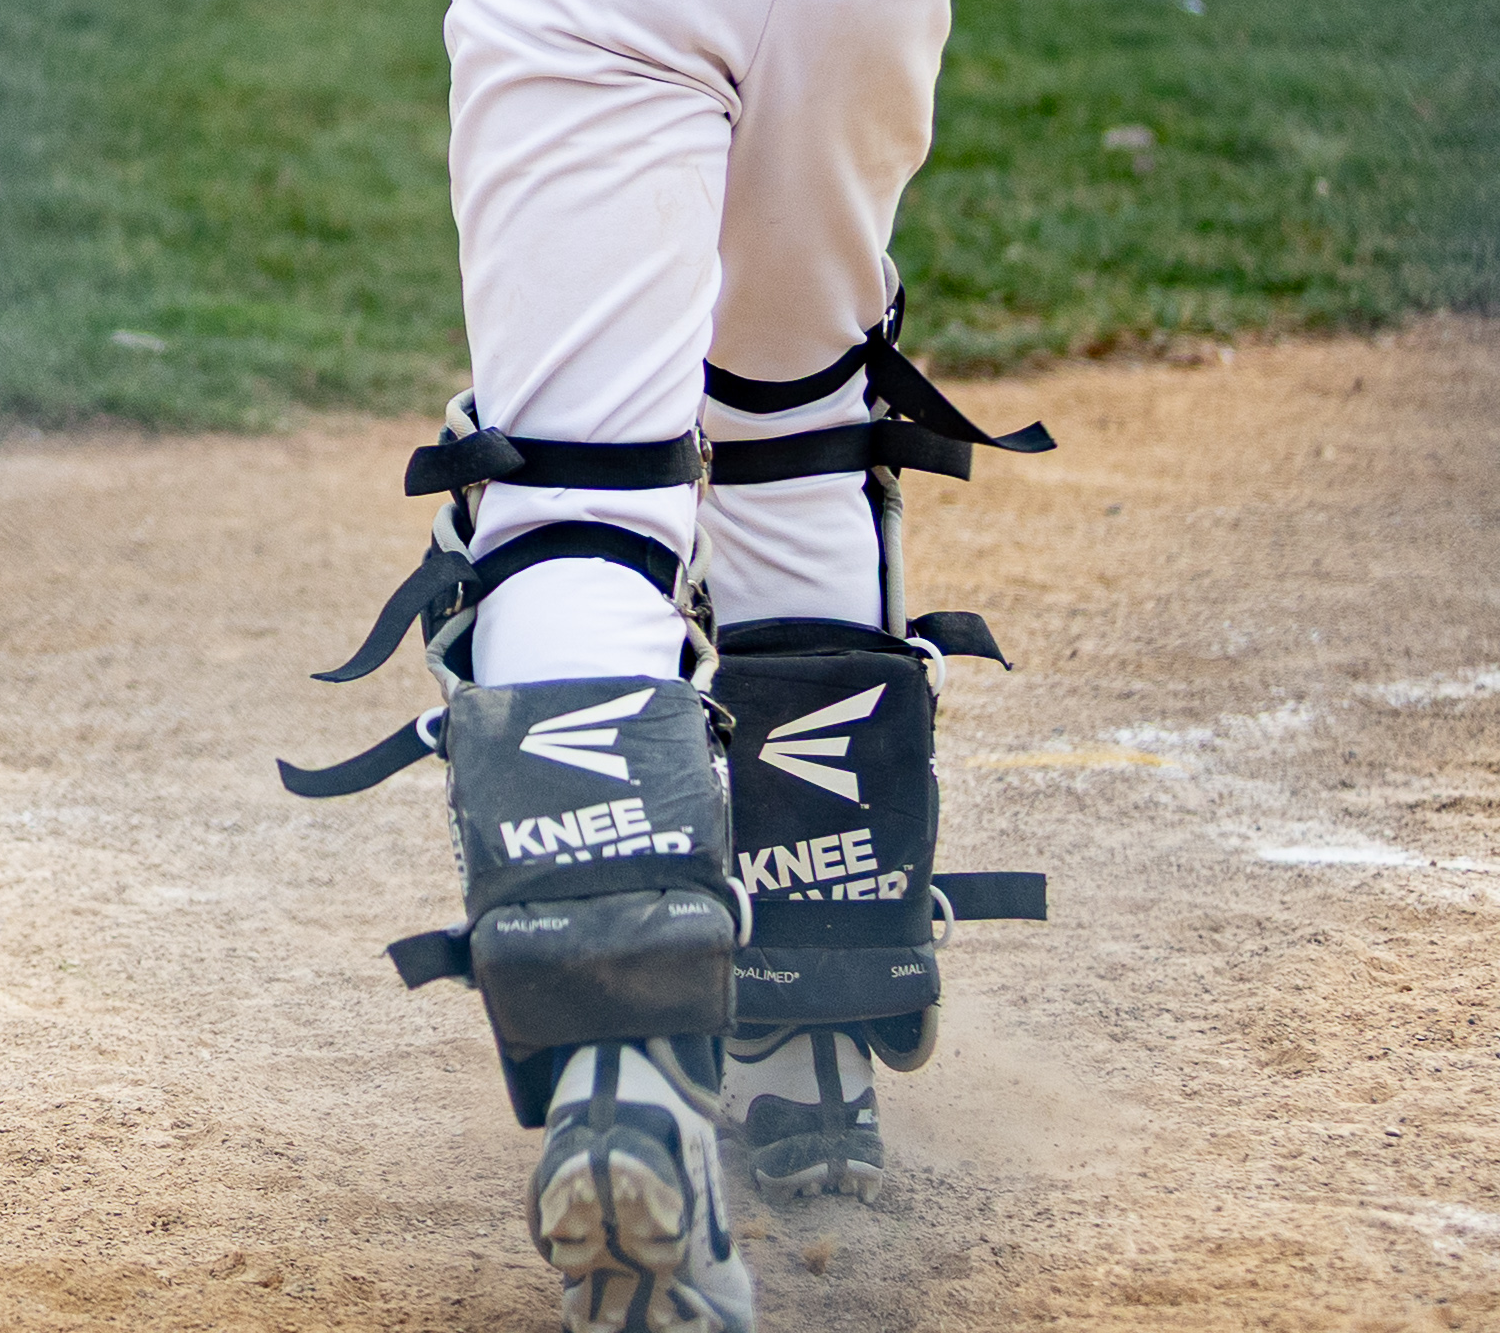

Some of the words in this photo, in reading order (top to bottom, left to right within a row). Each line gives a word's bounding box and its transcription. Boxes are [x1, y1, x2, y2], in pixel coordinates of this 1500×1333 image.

[500, 797, 651, 859] KNEE
[738, 827, 878, 894] KNEE
[668, 903, 711, 918] SMALL
